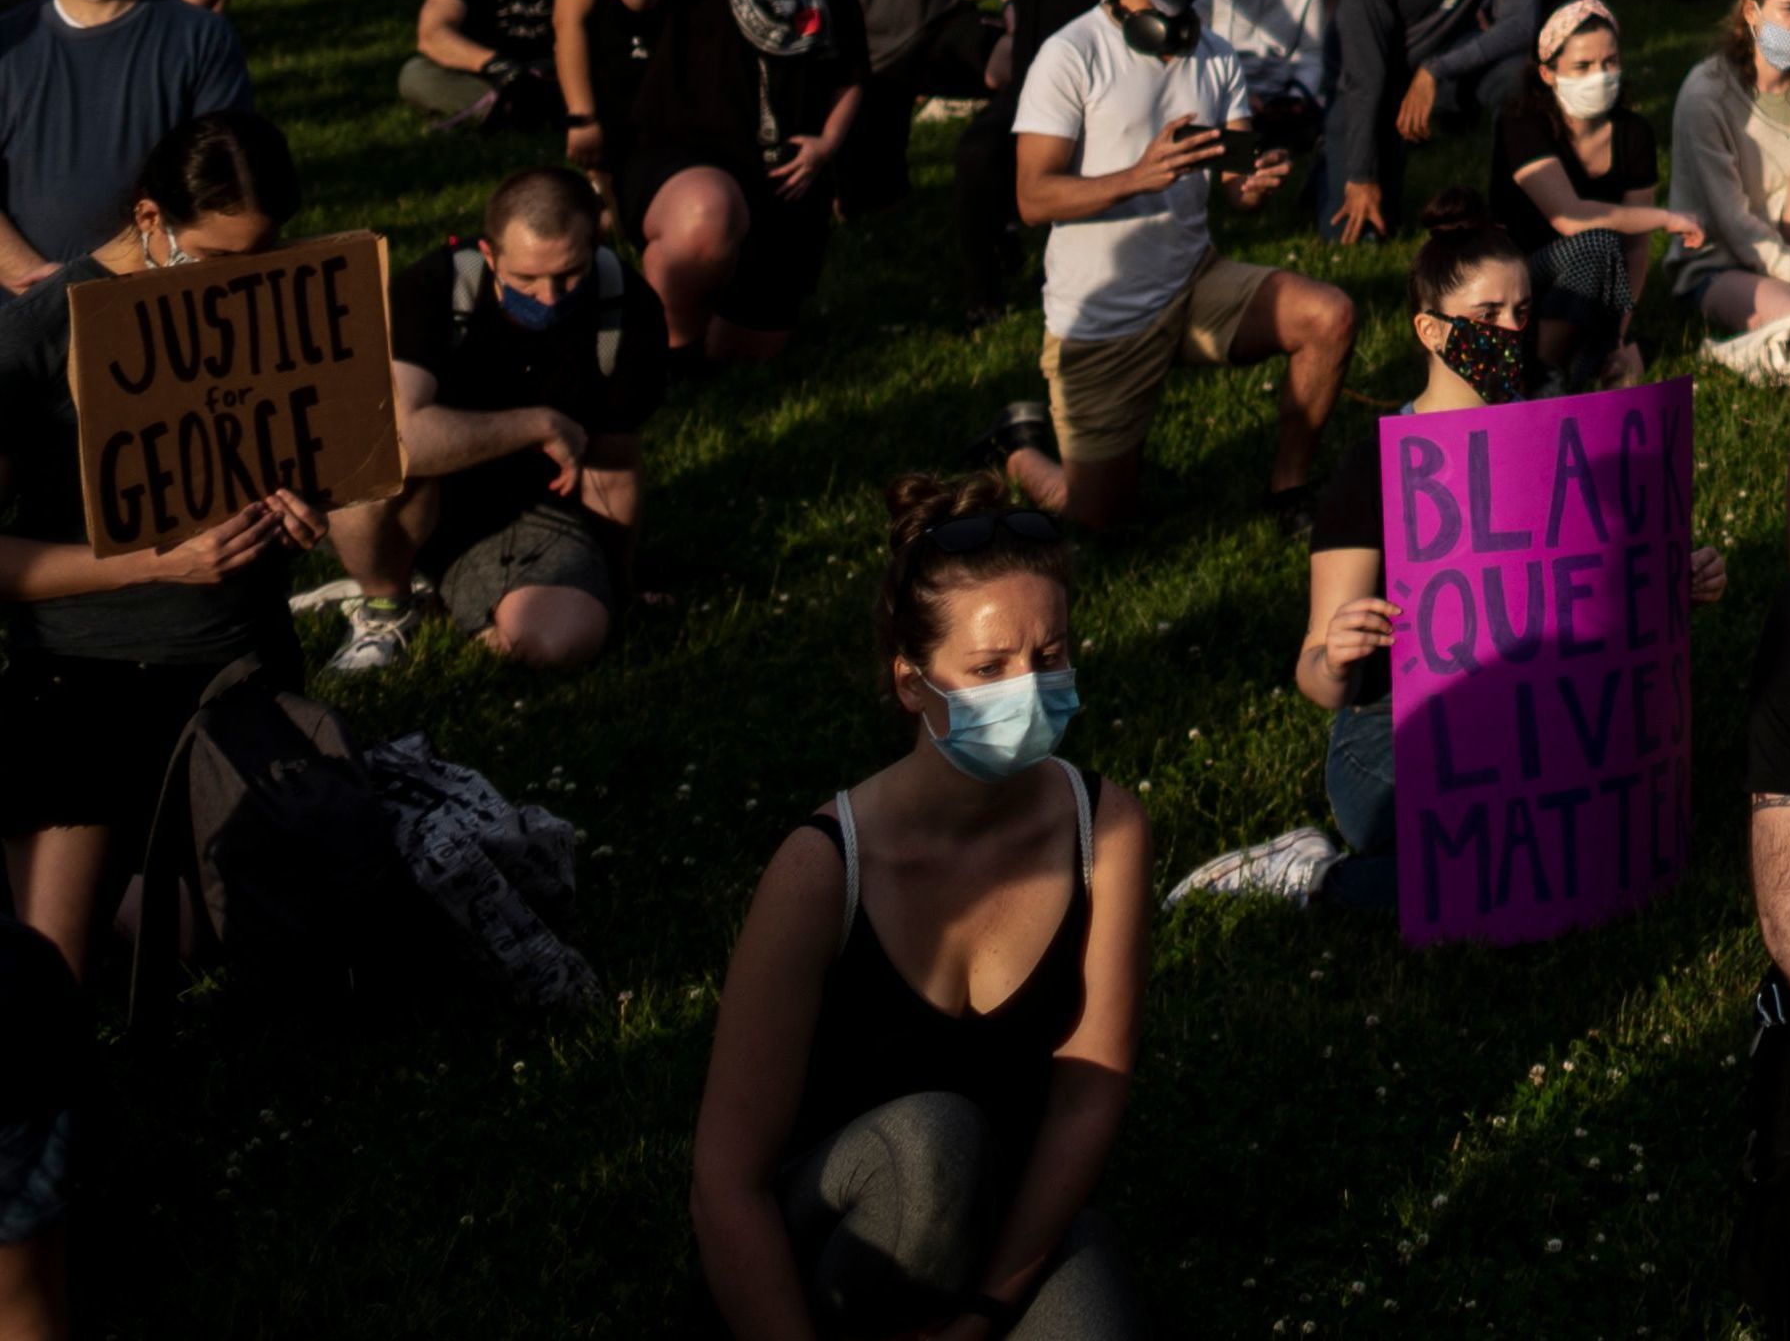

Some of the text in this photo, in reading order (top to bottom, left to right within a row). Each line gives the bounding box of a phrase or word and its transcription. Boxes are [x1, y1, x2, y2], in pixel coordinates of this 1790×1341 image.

[108, 254, 354, 395] JUSTICE
[100, 384, 333, 543] GEORGE
[204, 386, 254, 414] for
[1399, 405, 1683, 565] BLACK
[1416, 540, 1685, 677] QUEER
[1430, 653, 1685, 793] LIVES
[1418, 751, 1694, 923] MATTER
